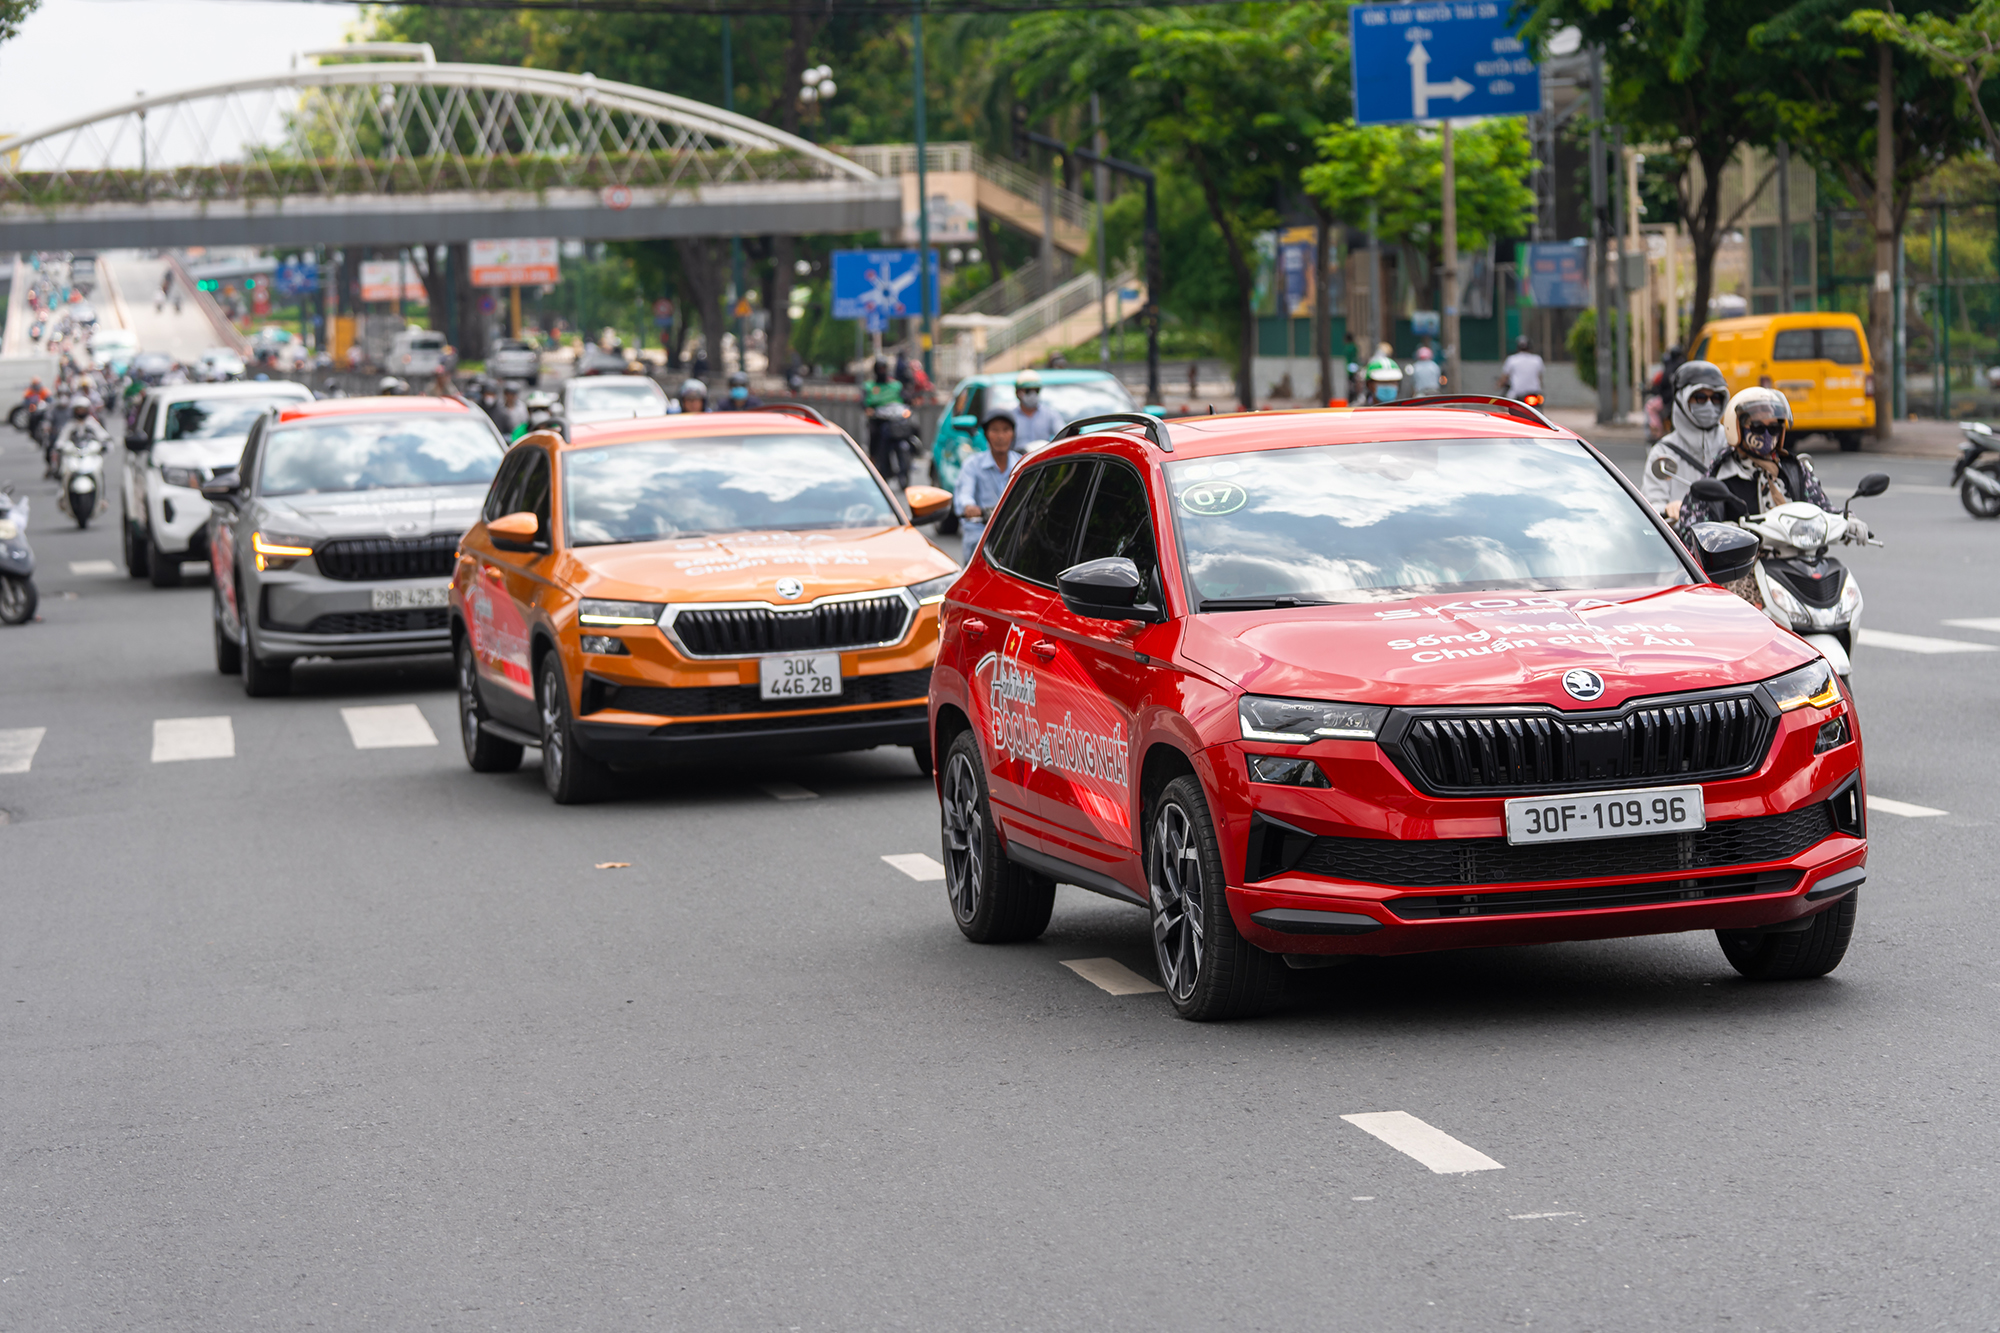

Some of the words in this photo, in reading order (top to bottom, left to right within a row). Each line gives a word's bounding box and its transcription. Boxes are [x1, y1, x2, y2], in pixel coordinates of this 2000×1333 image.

[1193, 487, 1232, 505] 07
[1386, 629, 1491, 651] Sống
[1495, 621, 1606, 635] khám
[1612, 622, 1686, 635] phá
[1411, 637, 1539, 663] Chuẩn
[1547, 633, 1635, 646] chất
[1640, 632, 1696, 647] Âu
[783, 658, 818, 677] 30K
[771, 676, 834, 696] 446.28
[1046, 710, 1098, 779] THỐNG
[1093, 722, 1130, 788] NHẤT
[1524, 796, 1687, 835] 30F-109.96
